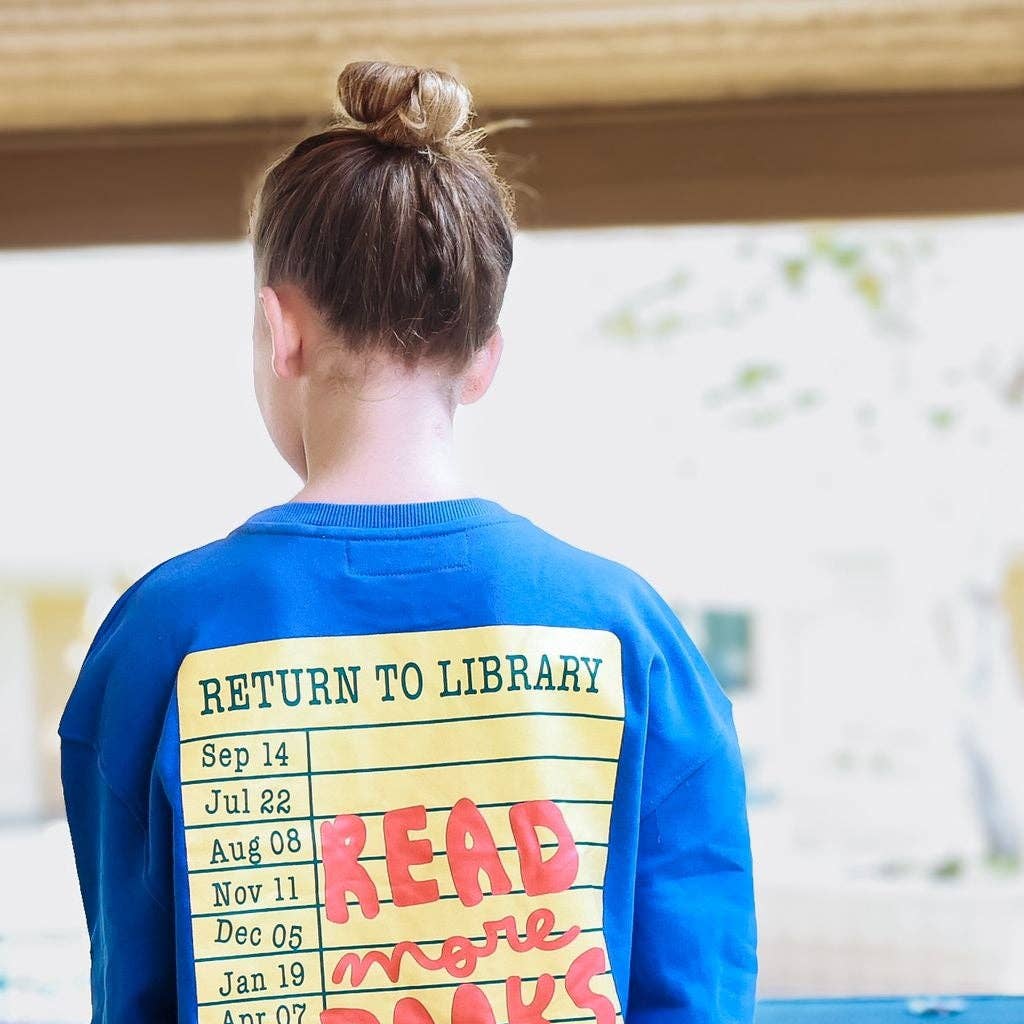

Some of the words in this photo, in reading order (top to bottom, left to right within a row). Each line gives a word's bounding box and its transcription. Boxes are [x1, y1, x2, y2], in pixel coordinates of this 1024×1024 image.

[199, 665, 361, 716] RETURN
[375, 661, 424, 702] TO
[438, 654, 604, 698] LIBRARY
[202, 743, 250, 772] Sep
[262, 742, 289, 767] 14
[205, 789, 251, 815] Jul
[260, 789, 291, 814] 22
[209, 837, 262, 865] Aug
[270, 828, 302, 857] 08
[320, 797, 579, 924] READ
[211, 879, 263, 908] Nov
[274, 876, 299, 902] 11
[214, 919, 262, 946] Dec
[272, 924, 303, 952] 05
[332, 907, 581, 987] more
[219, 970, 267, 997] Jan
[278, 961, 305, 988] 19
